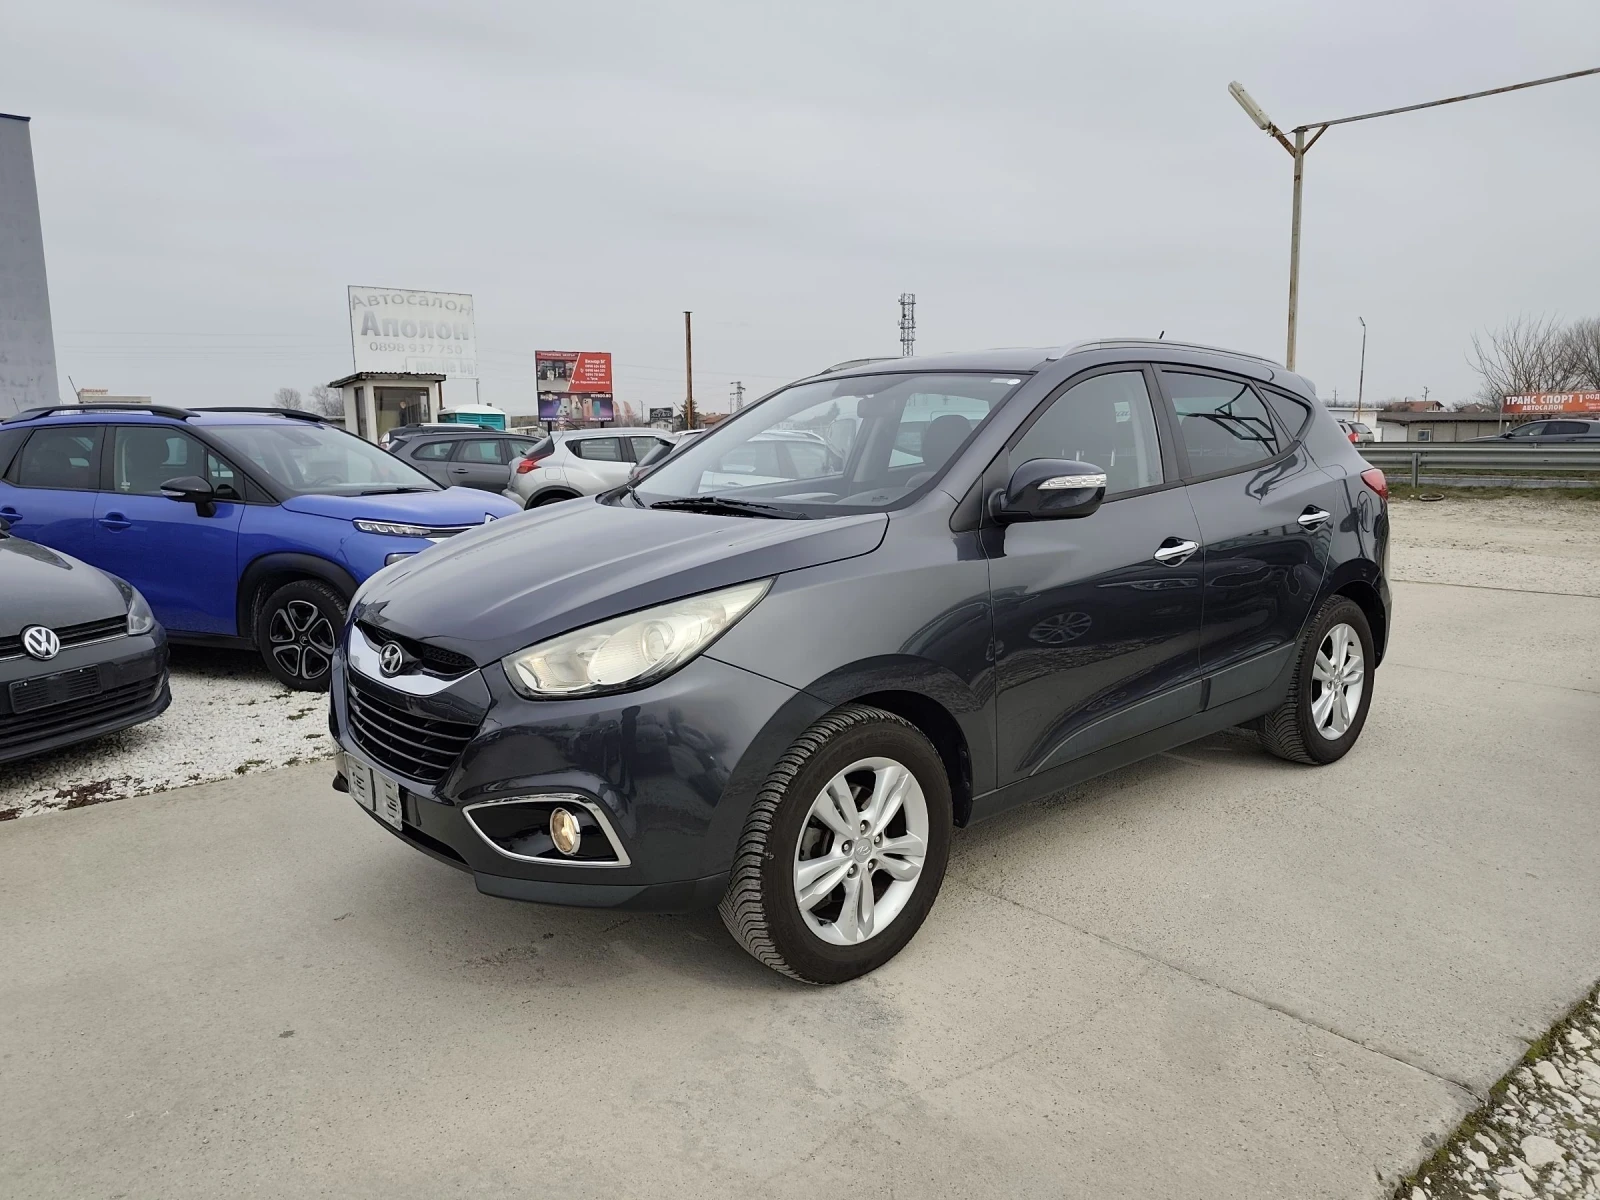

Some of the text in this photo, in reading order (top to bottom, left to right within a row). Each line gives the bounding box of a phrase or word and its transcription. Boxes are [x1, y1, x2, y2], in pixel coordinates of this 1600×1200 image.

[351, 292, 472, 316] Автосалон
[360, 310, 470, 341] Аполон
[369, 341, 463, 356] 0898 937 750
[1506, 395, 1536, 405] ТРАНС
[1540, 394, 1574, 404] СПОРТ
